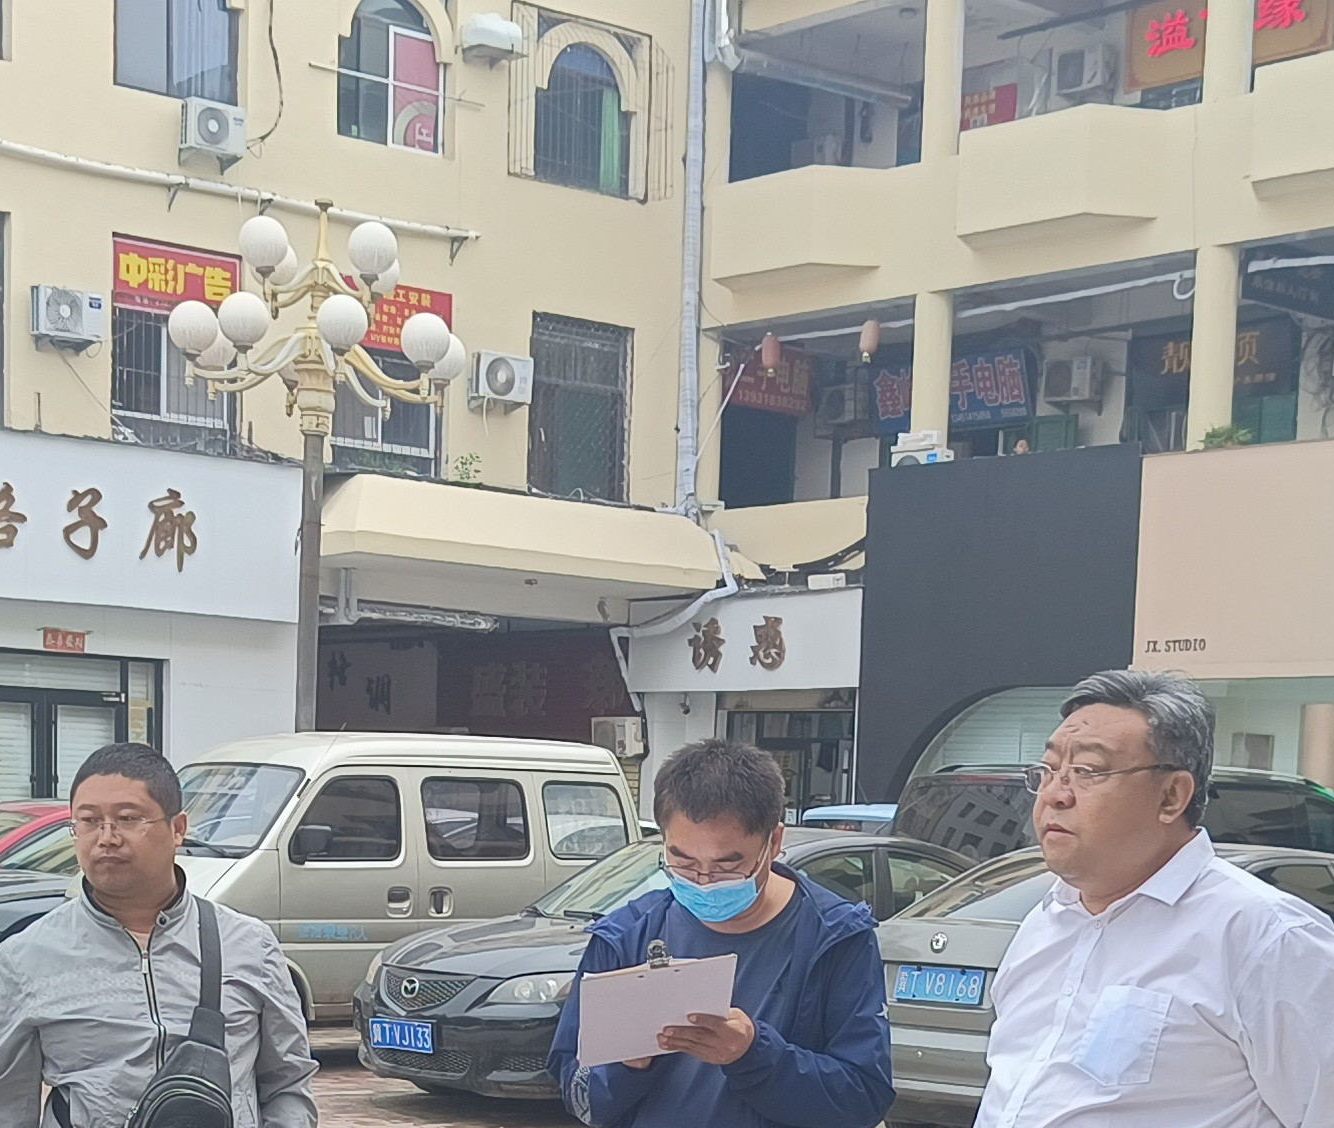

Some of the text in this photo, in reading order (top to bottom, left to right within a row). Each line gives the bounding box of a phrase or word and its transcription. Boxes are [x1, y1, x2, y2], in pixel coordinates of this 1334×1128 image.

[118, 252, 232, 301] 中彩广告
[1164, 638, 1207, 652] STUDIO
